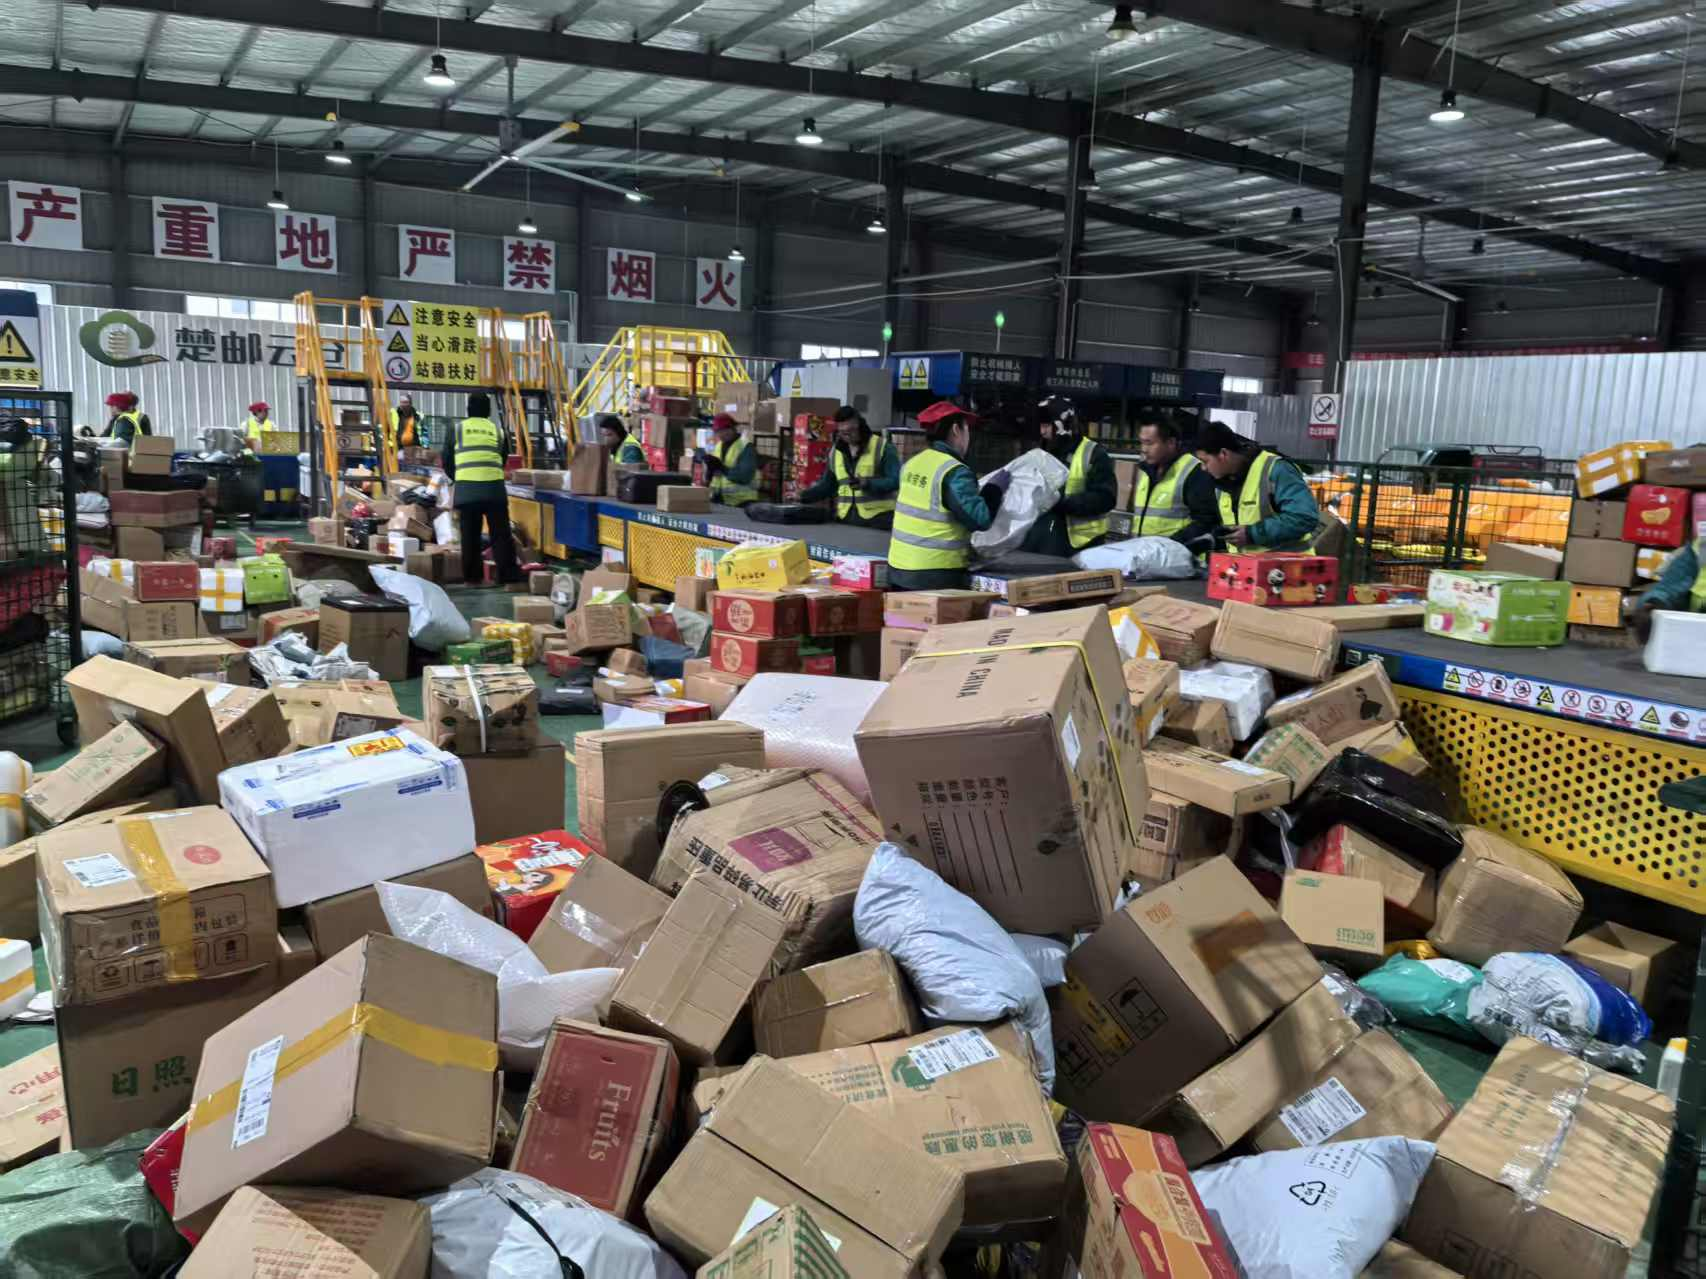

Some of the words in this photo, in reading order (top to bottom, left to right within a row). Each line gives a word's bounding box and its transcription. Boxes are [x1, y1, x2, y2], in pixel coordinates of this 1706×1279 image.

[16, 187, 77, 242] 产
[157, 203, 215, 259] 重
[280, 215, 334, 269] 地
[403, 229, 452, 277] 严
[507, 240, 552, 289] 禁
[611, 252, 653, 298] 烟
[701, 263, 736, 307] 火
[415, 307, 476, 329] 注意安全
[415, 334, 477, 354] 当心滑跌
[415, 360, 477, 381] 站稳扶好
[986, 627, 1016, 648] MAD
[975, 653, 1000, 665] IN
[955, 667, 992, 698] CHINA
[587, 1080, 633, 1162] Fruits
